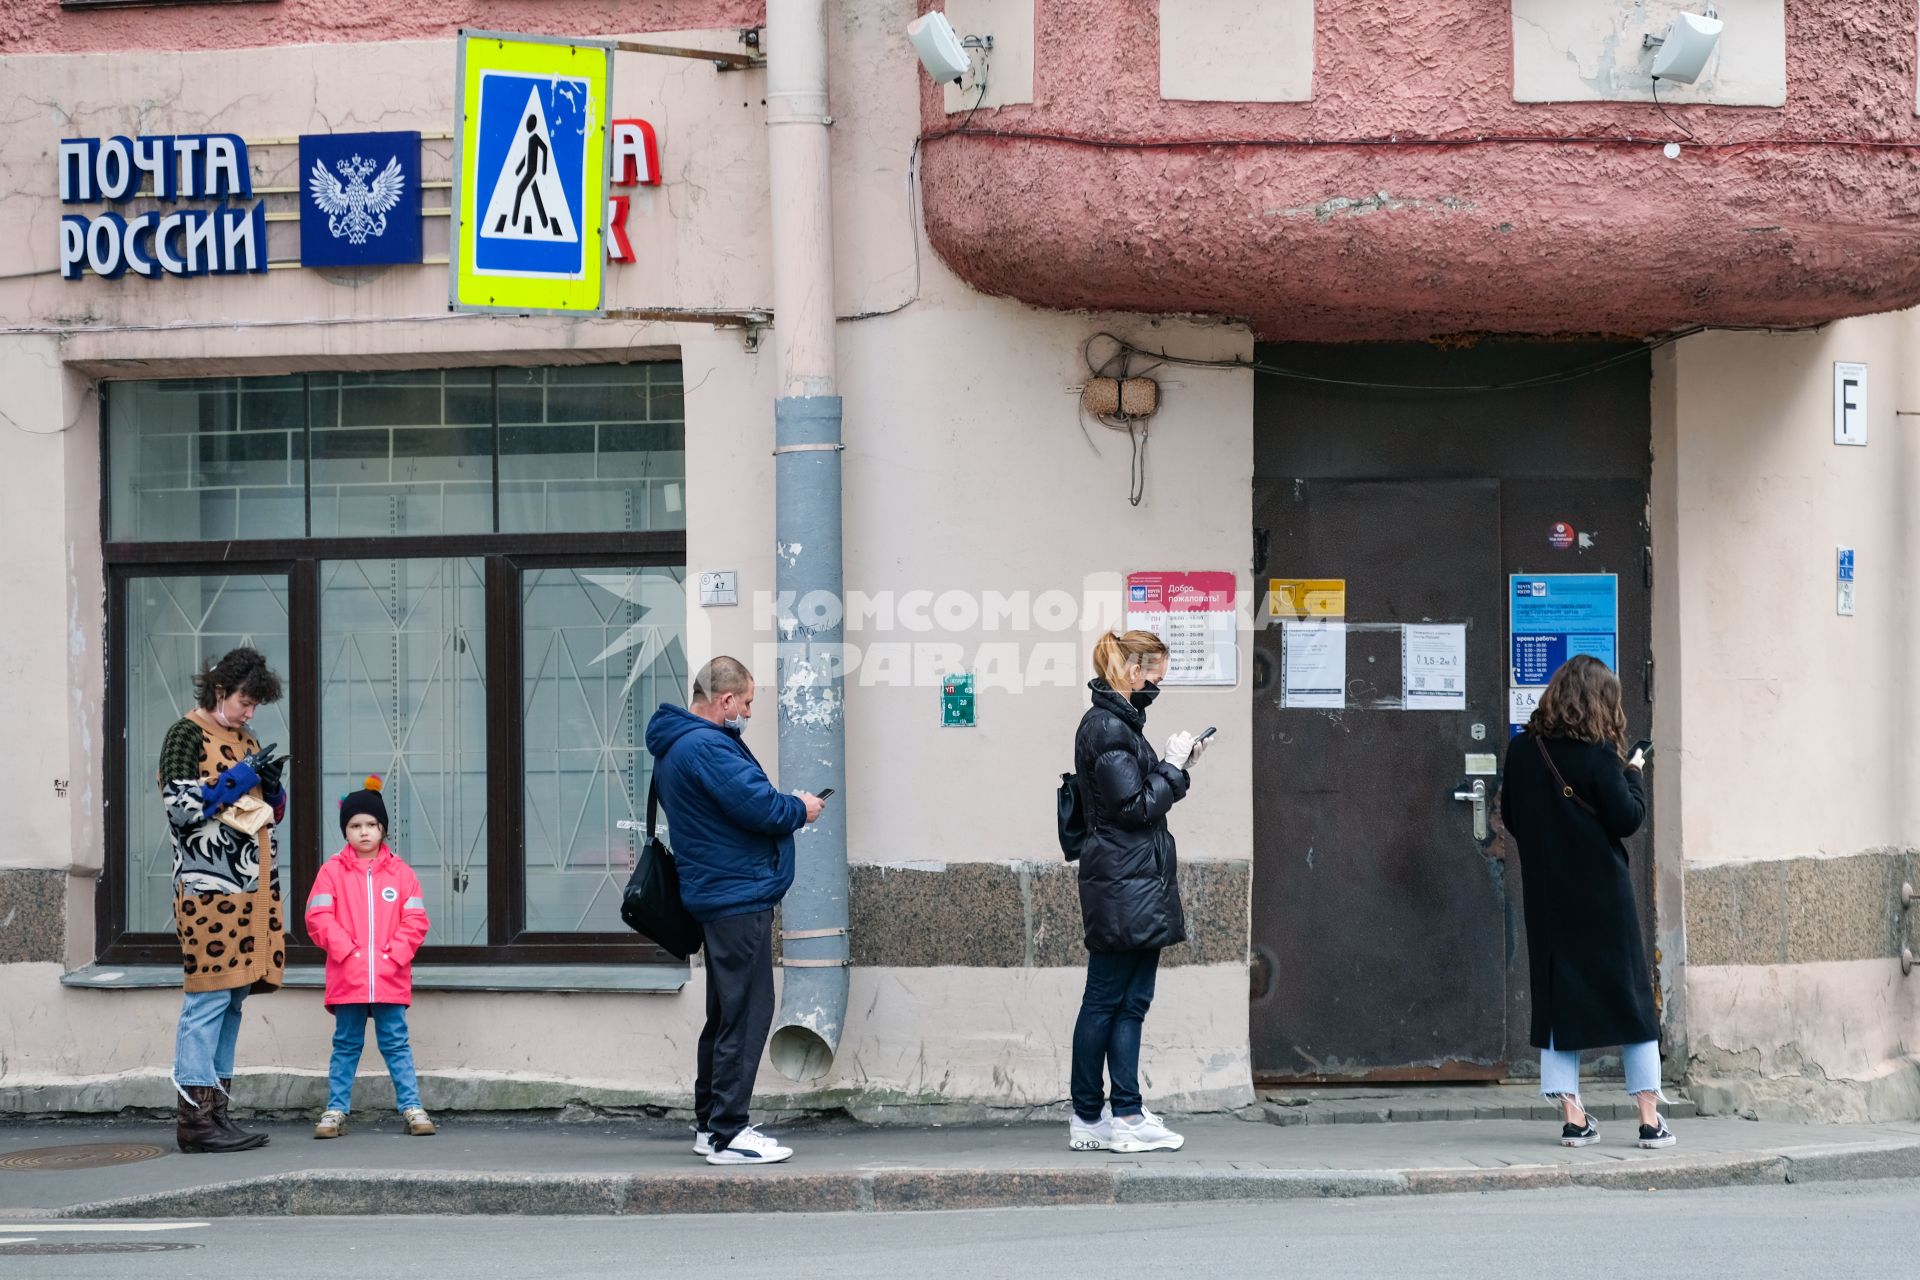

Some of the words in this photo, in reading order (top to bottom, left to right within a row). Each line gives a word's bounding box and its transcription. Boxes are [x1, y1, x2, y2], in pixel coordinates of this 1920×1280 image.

[59, 134, 252, 204] ПОЧТА
[60, 200, 267, 279] РОССИИ
[1843, 379, 1858, 434] F
[1168, 584, 1194, 594] Добро
[1168, 594, 1220, 602] пожаловать!
